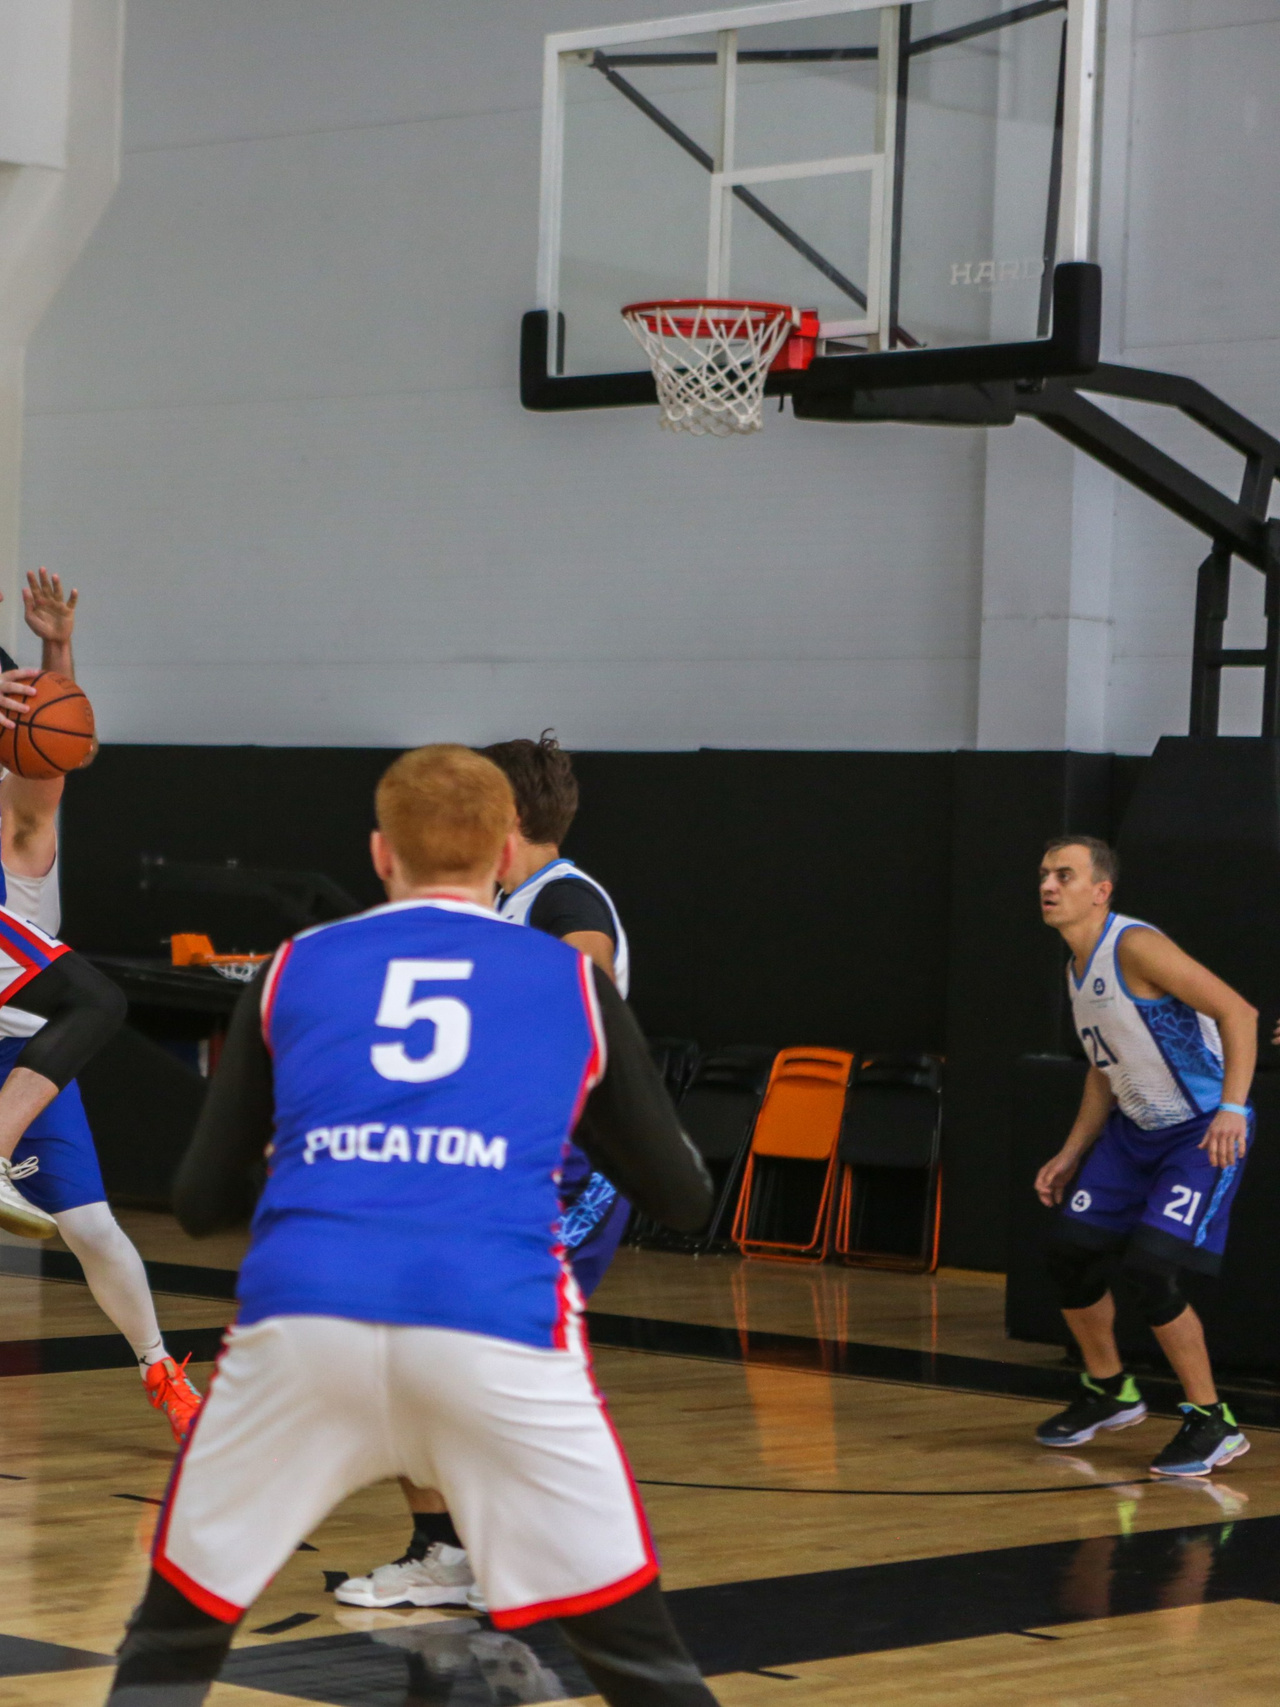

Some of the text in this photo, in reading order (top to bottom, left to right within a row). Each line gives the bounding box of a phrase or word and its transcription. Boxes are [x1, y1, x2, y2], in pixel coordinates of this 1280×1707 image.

[371, 959, 474, 1083] 5
[1081, 1026, 1118, 1067] 21
[303, 1122, 508, 1170] РОСАТОМ
[1163, 1185, 1202, 1226] 21
